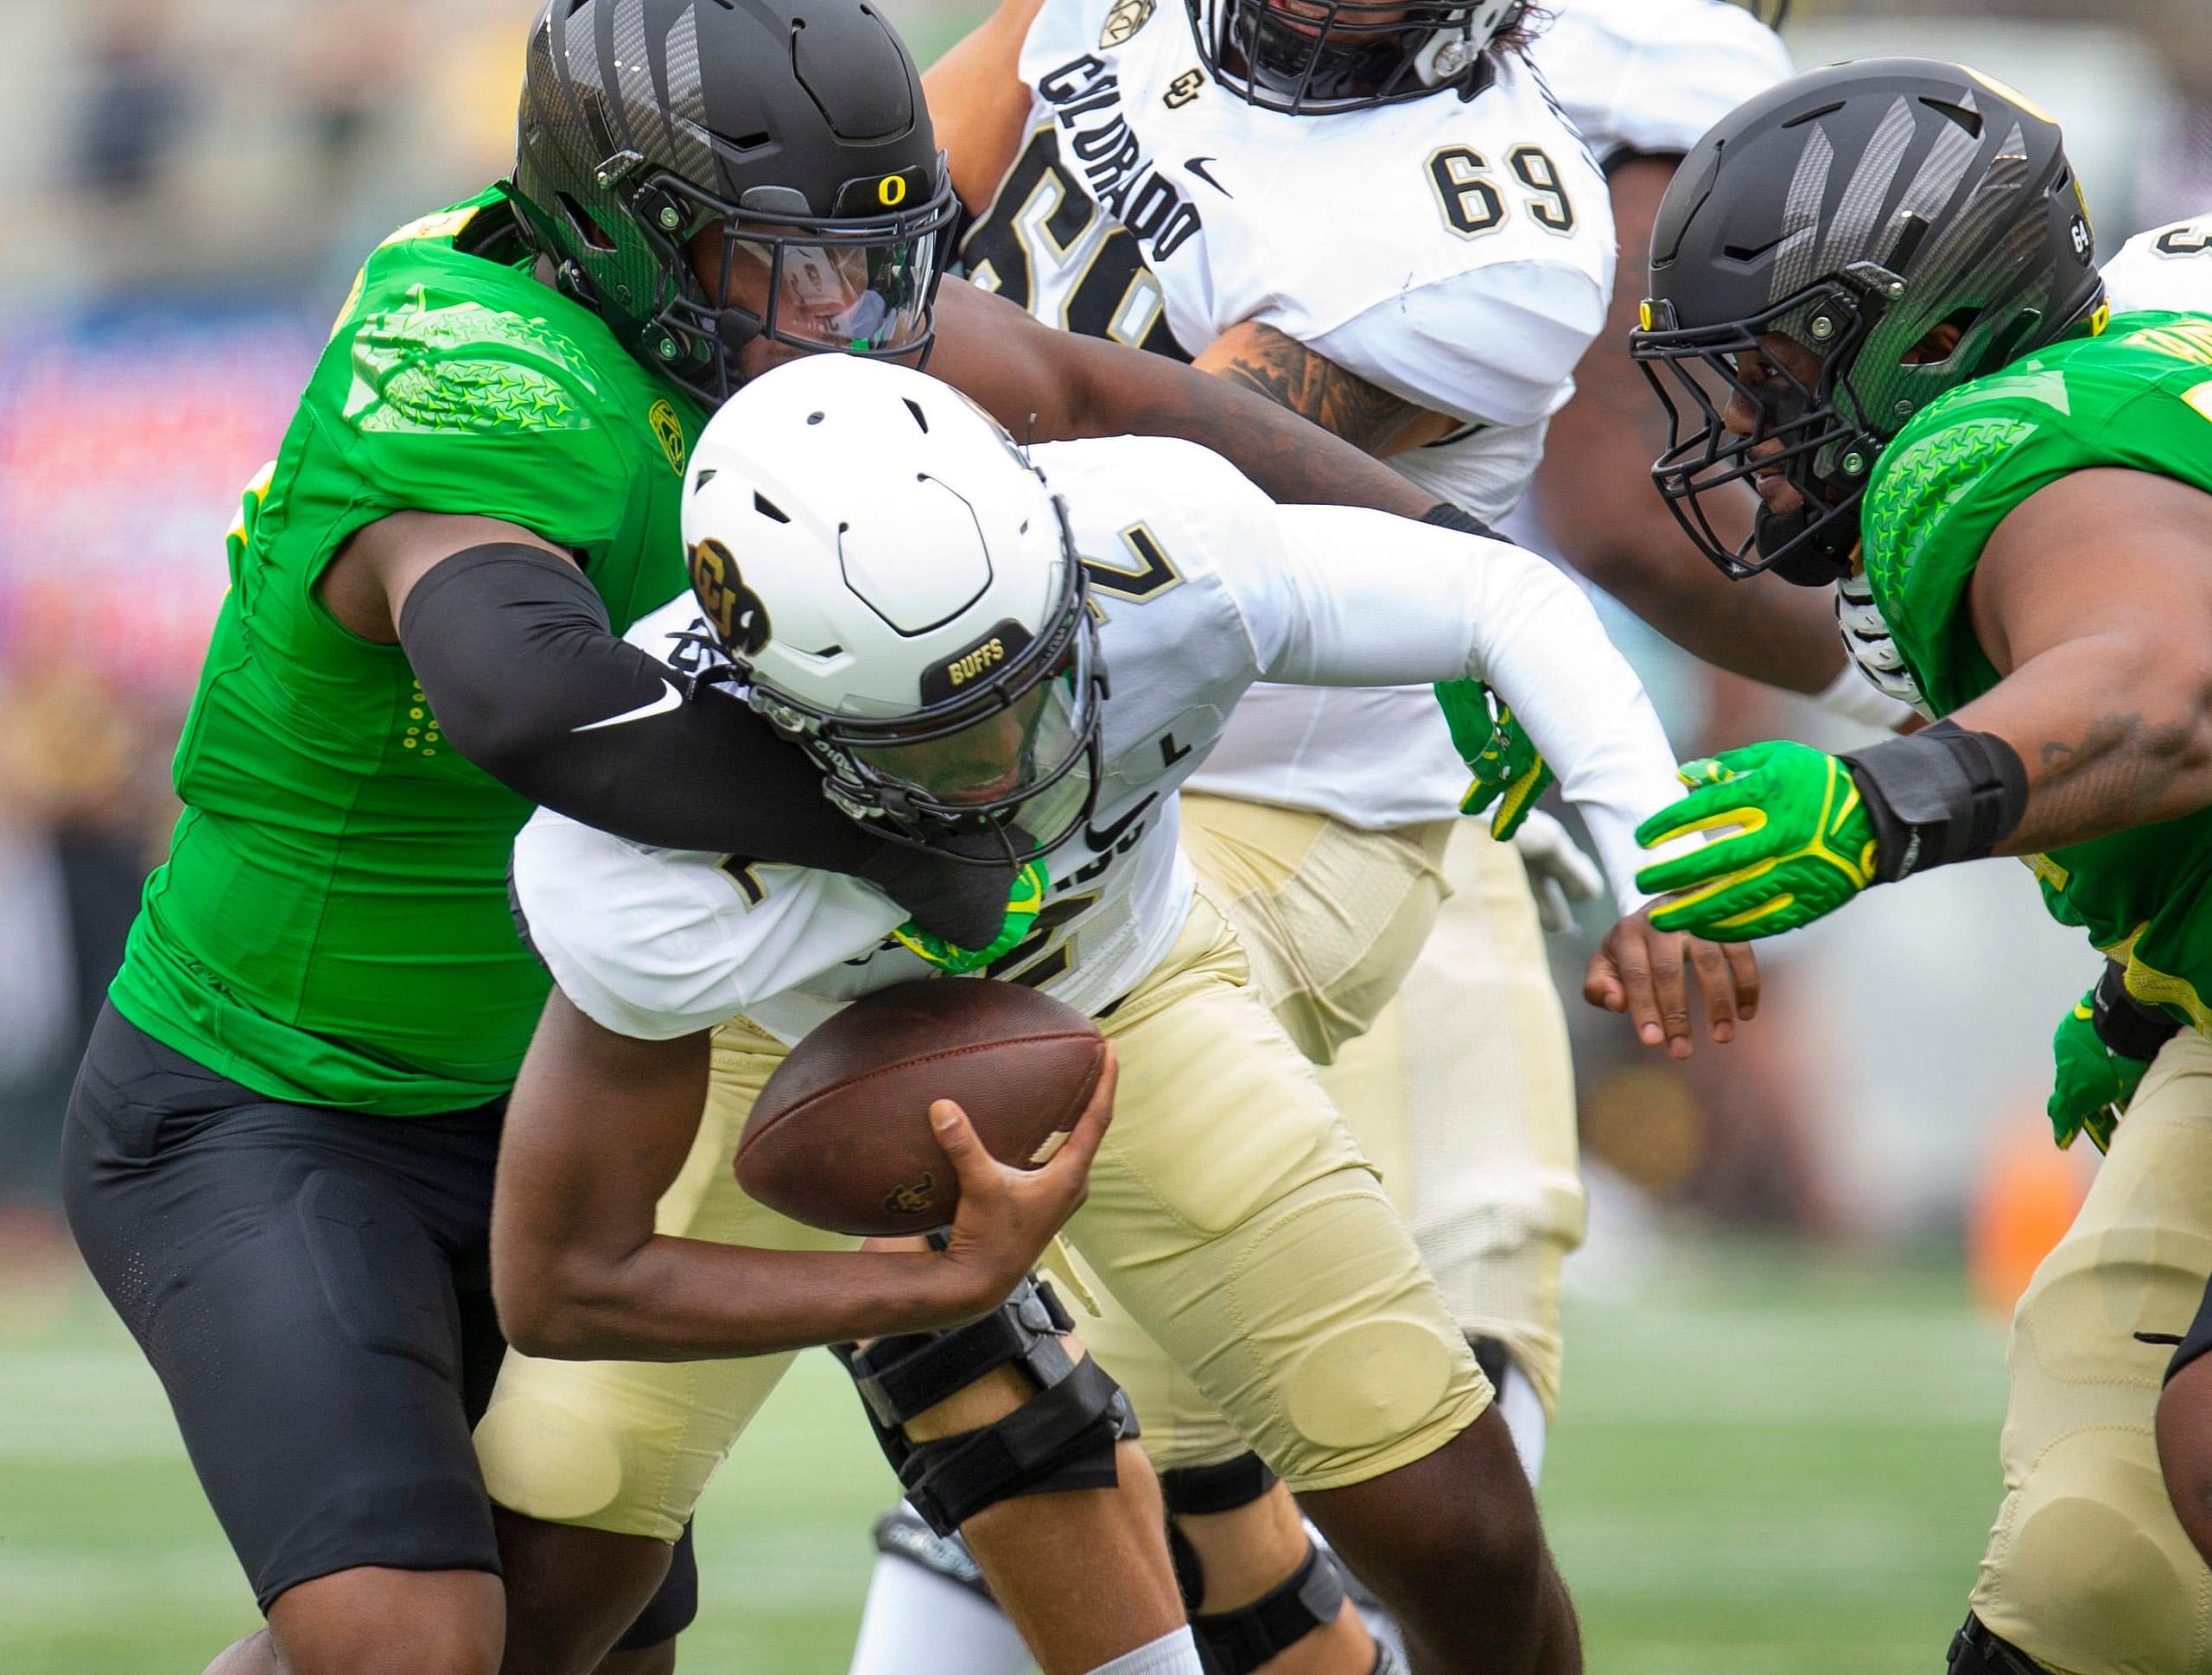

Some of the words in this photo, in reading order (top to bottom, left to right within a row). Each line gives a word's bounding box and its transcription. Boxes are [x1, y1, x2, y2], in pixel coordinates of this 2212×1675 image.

[879, 175, 906, 206] O
[1422, 143, 1580, 241] 69
[2071, 220, 2089, 253] 64
[948, 638, 1004, 685] BUFFS
